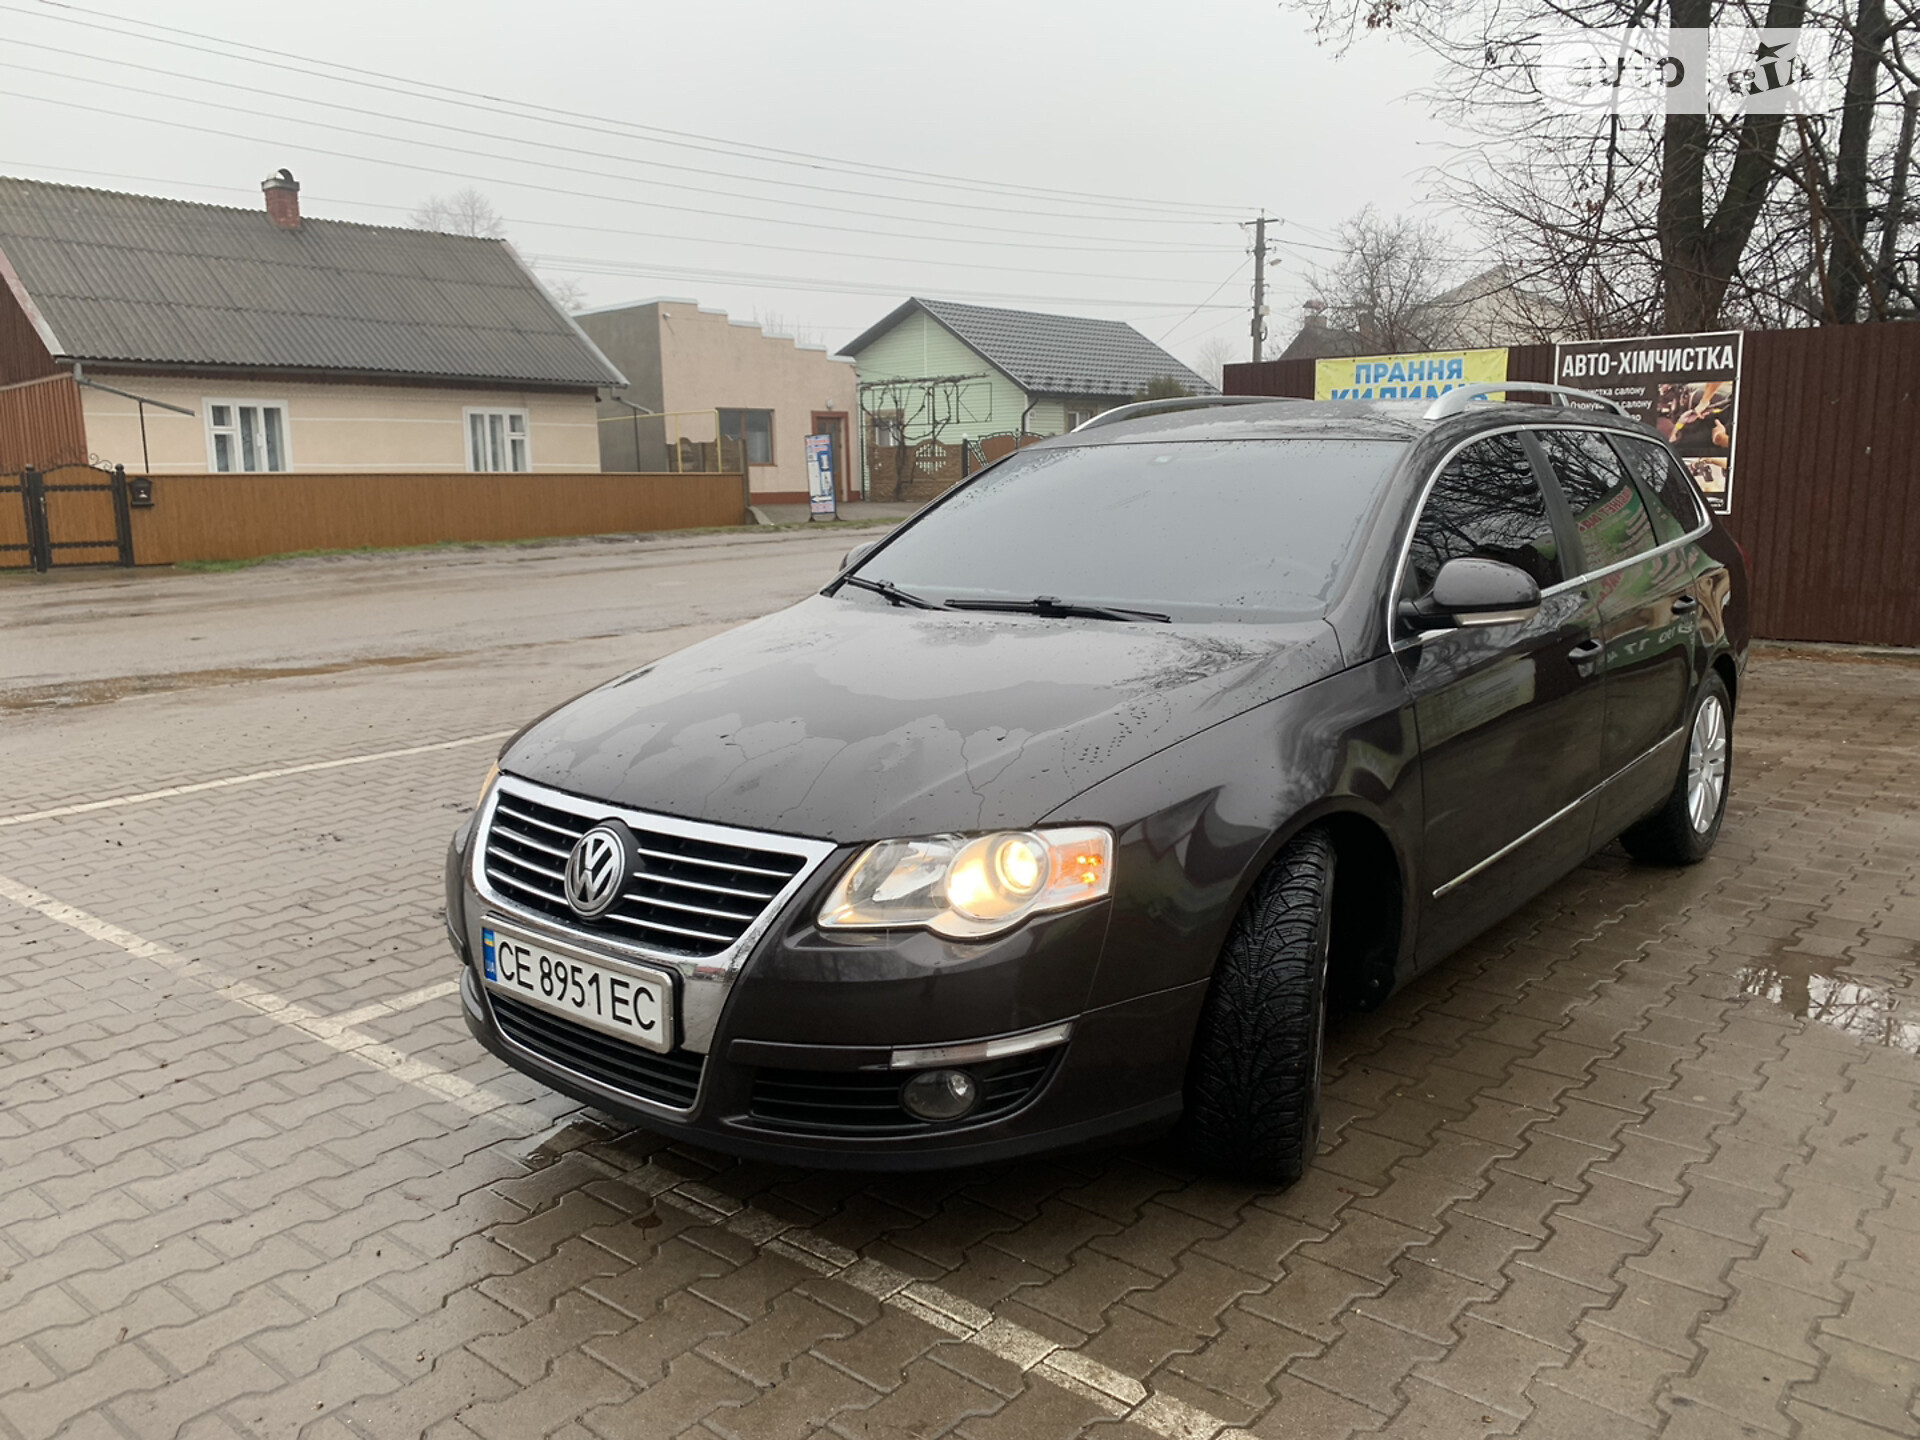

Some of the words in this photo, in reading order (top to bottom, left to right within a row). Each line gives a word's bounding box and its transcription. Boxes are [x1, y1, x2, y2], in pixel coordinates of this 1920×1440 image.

[1355, 358, 1463, 384] ПРАННЯ
[1562, 345, 1734, 377] АВТО-ХІМЧИСТКА
[498, 941, 534, 991] CE
[539, 955, 602, 1016] 8951
[610, 977, 656, 1031] EC
